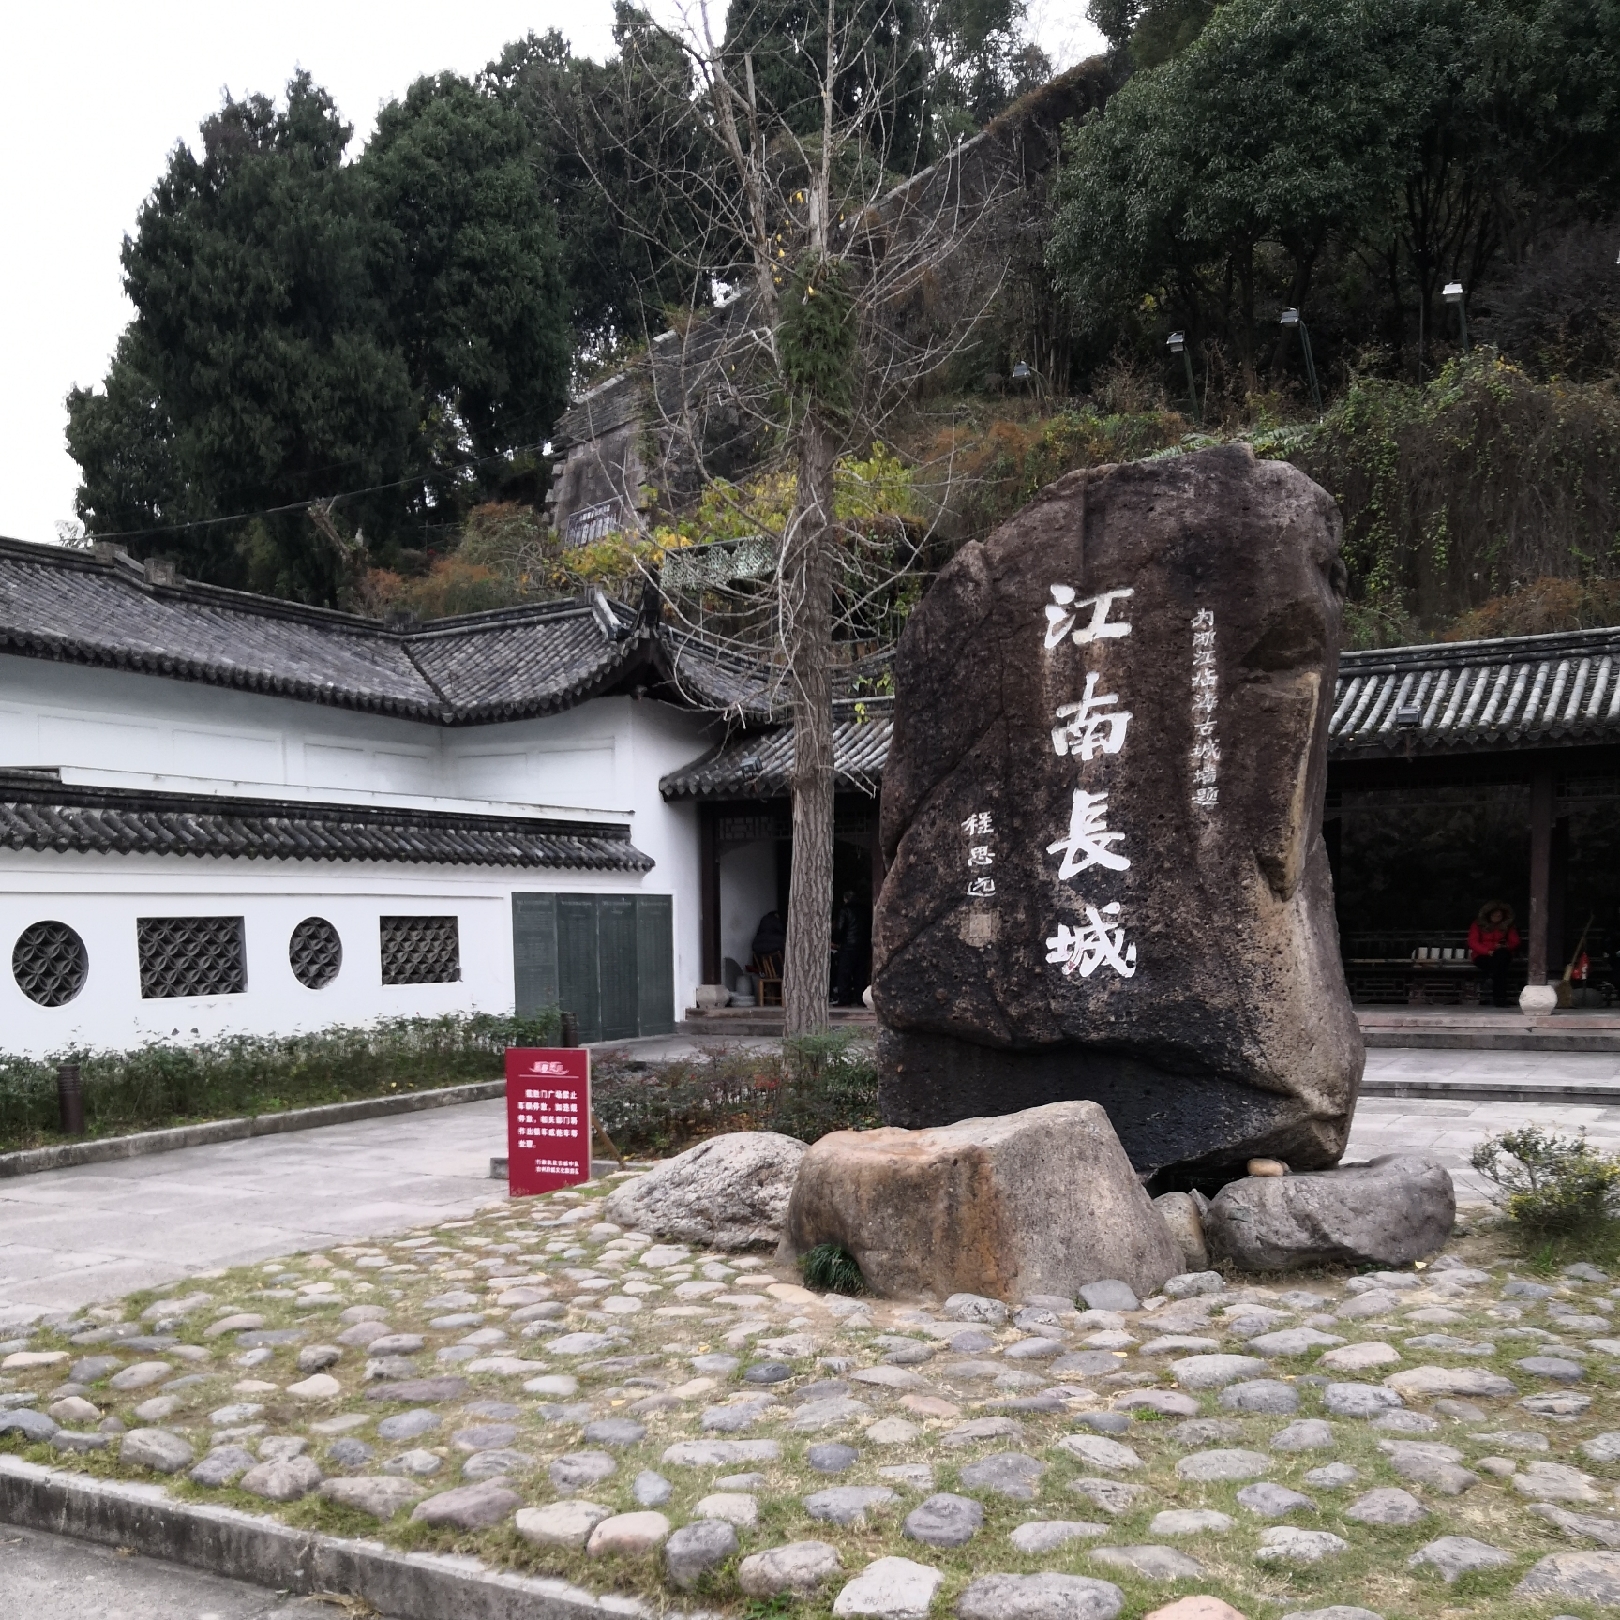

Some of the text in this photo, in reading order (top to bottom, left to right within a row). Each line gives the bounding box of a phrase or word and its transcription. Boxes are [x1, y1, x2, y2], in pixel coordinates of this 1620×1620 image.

[961, 811, 996, 897] 程思远
[1045, 584, 1137, 978] 江南長城
